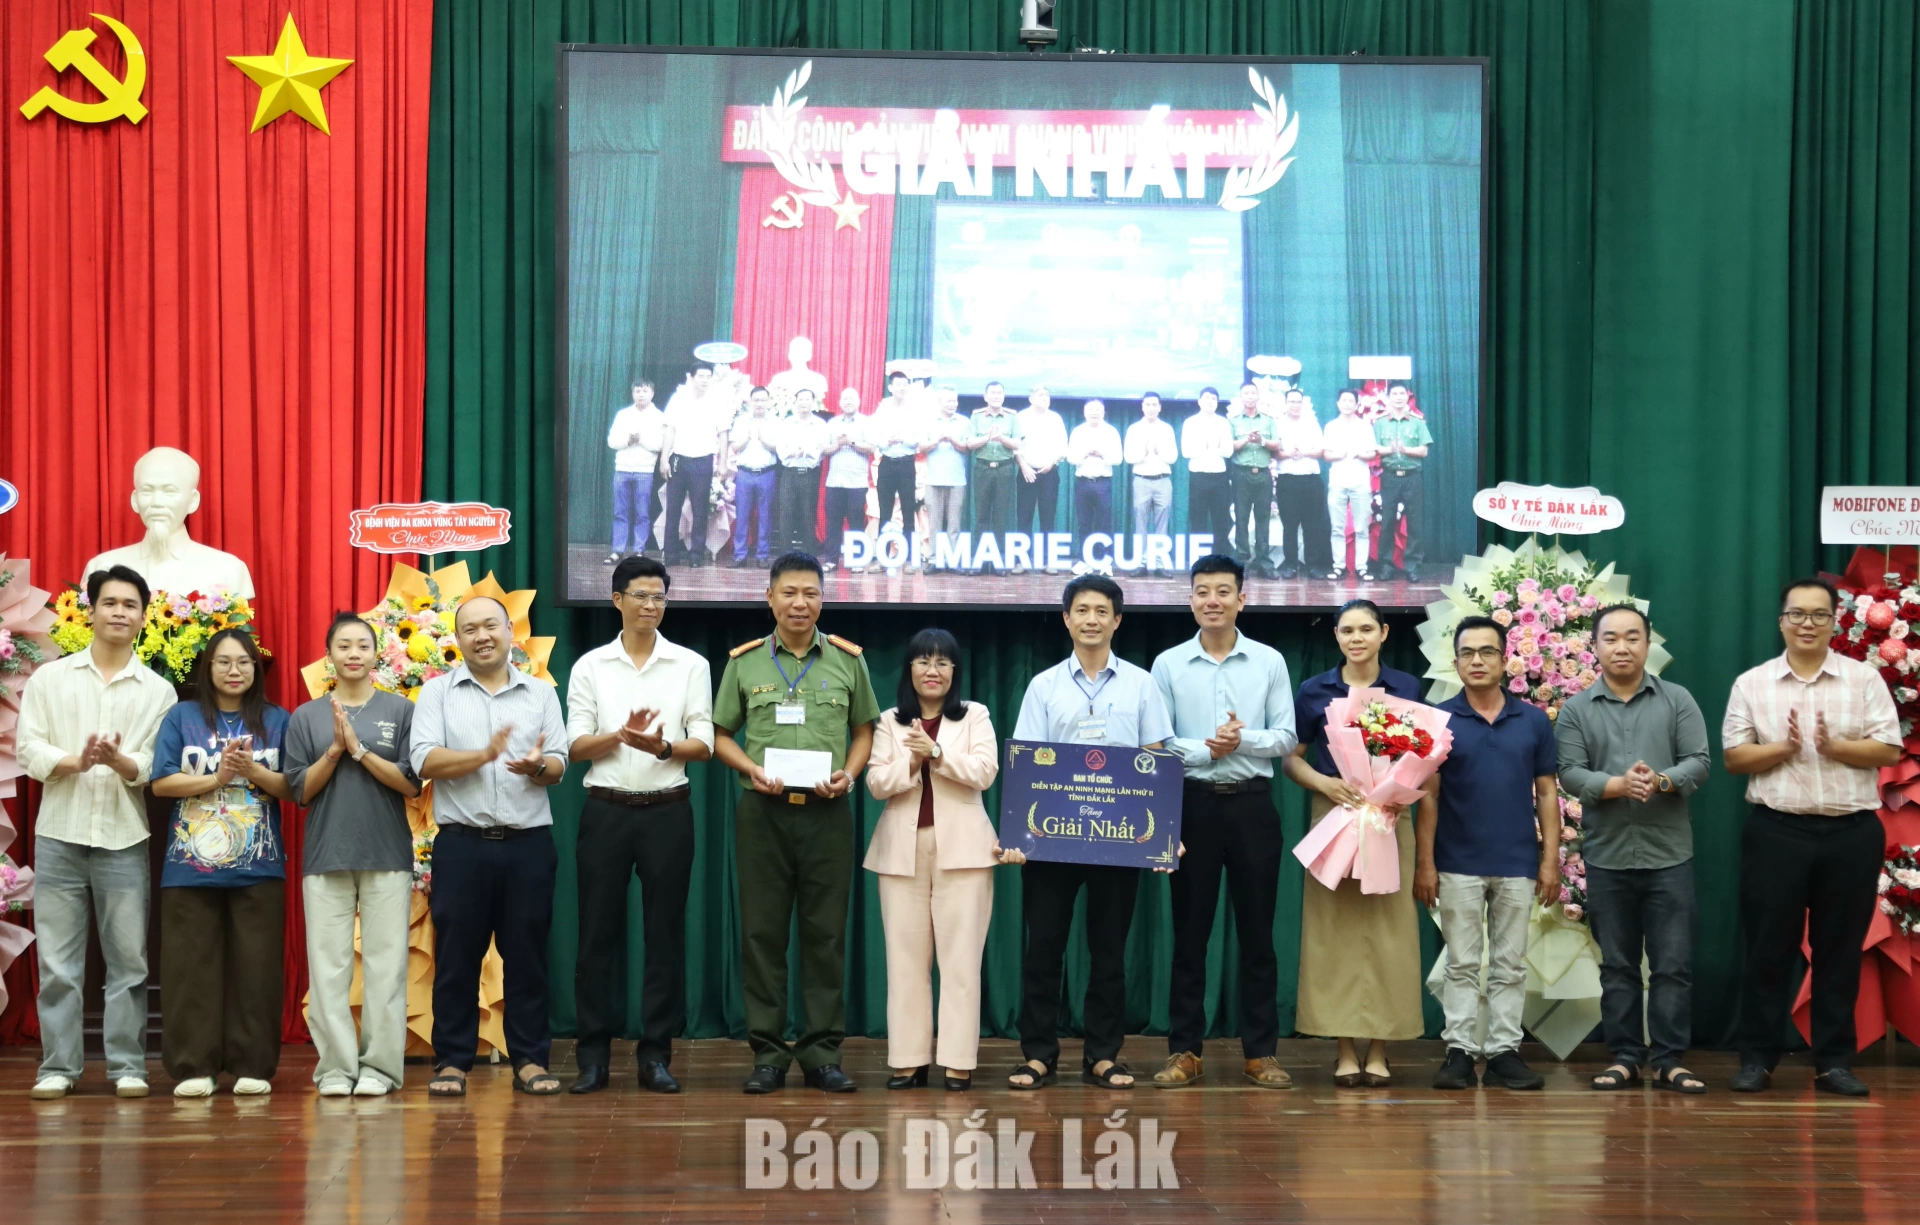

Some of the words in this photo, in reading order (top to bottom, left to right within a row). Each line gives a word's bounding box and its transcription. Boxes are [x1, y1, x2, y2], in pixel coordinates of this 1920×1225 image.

[842, 108, 993, 197] GIẢI
[1015, 105, 1217, 198] NHẤT
[1488, 494, 1507, 510] SỞ
[1511, 498, 1520, 511] Y
[1524, 497, 1543, 513] TẾ
[1832, 497, 1907, 512] MOBIFONE
[365, 516, 383, 531] BỆNH
[384, 515, 400, 530] VIỆN
[401, 517, 411, 528] ĐA
[412, 517, 432, 528] KHOA
[433, 515, 453, 528] VÙNG
[454, 515, 467, 527] TÂY
[468, 515, 496, 527] NGUYÊN
[1511, 513, 1543, 529] Chúc
[1850, 519, 1892, 536] Chúc
[388, 529, 427, 545] Chúc
[841, 521, 921, 577] ĐỘI
[935, 531, 1073, 570] MARIE
[1082, 531, 1214, 571] CURIE
[1073, 774, 1086, 783] BAN
[1087, 772, 1096, 783] TỔ
[1096, 774, 1113, 784] CHỨC
[1031, 780, 1049, 790] DIỄN
[1049, 782, 1063, 792] TẬP
[1075, 785, 1093, 793] NINH
[1094, 786, 1116, 795] MẠNG
[1042, 816, 1083, 836] Giải
[1088, 816, 1136, 840] Nhất
